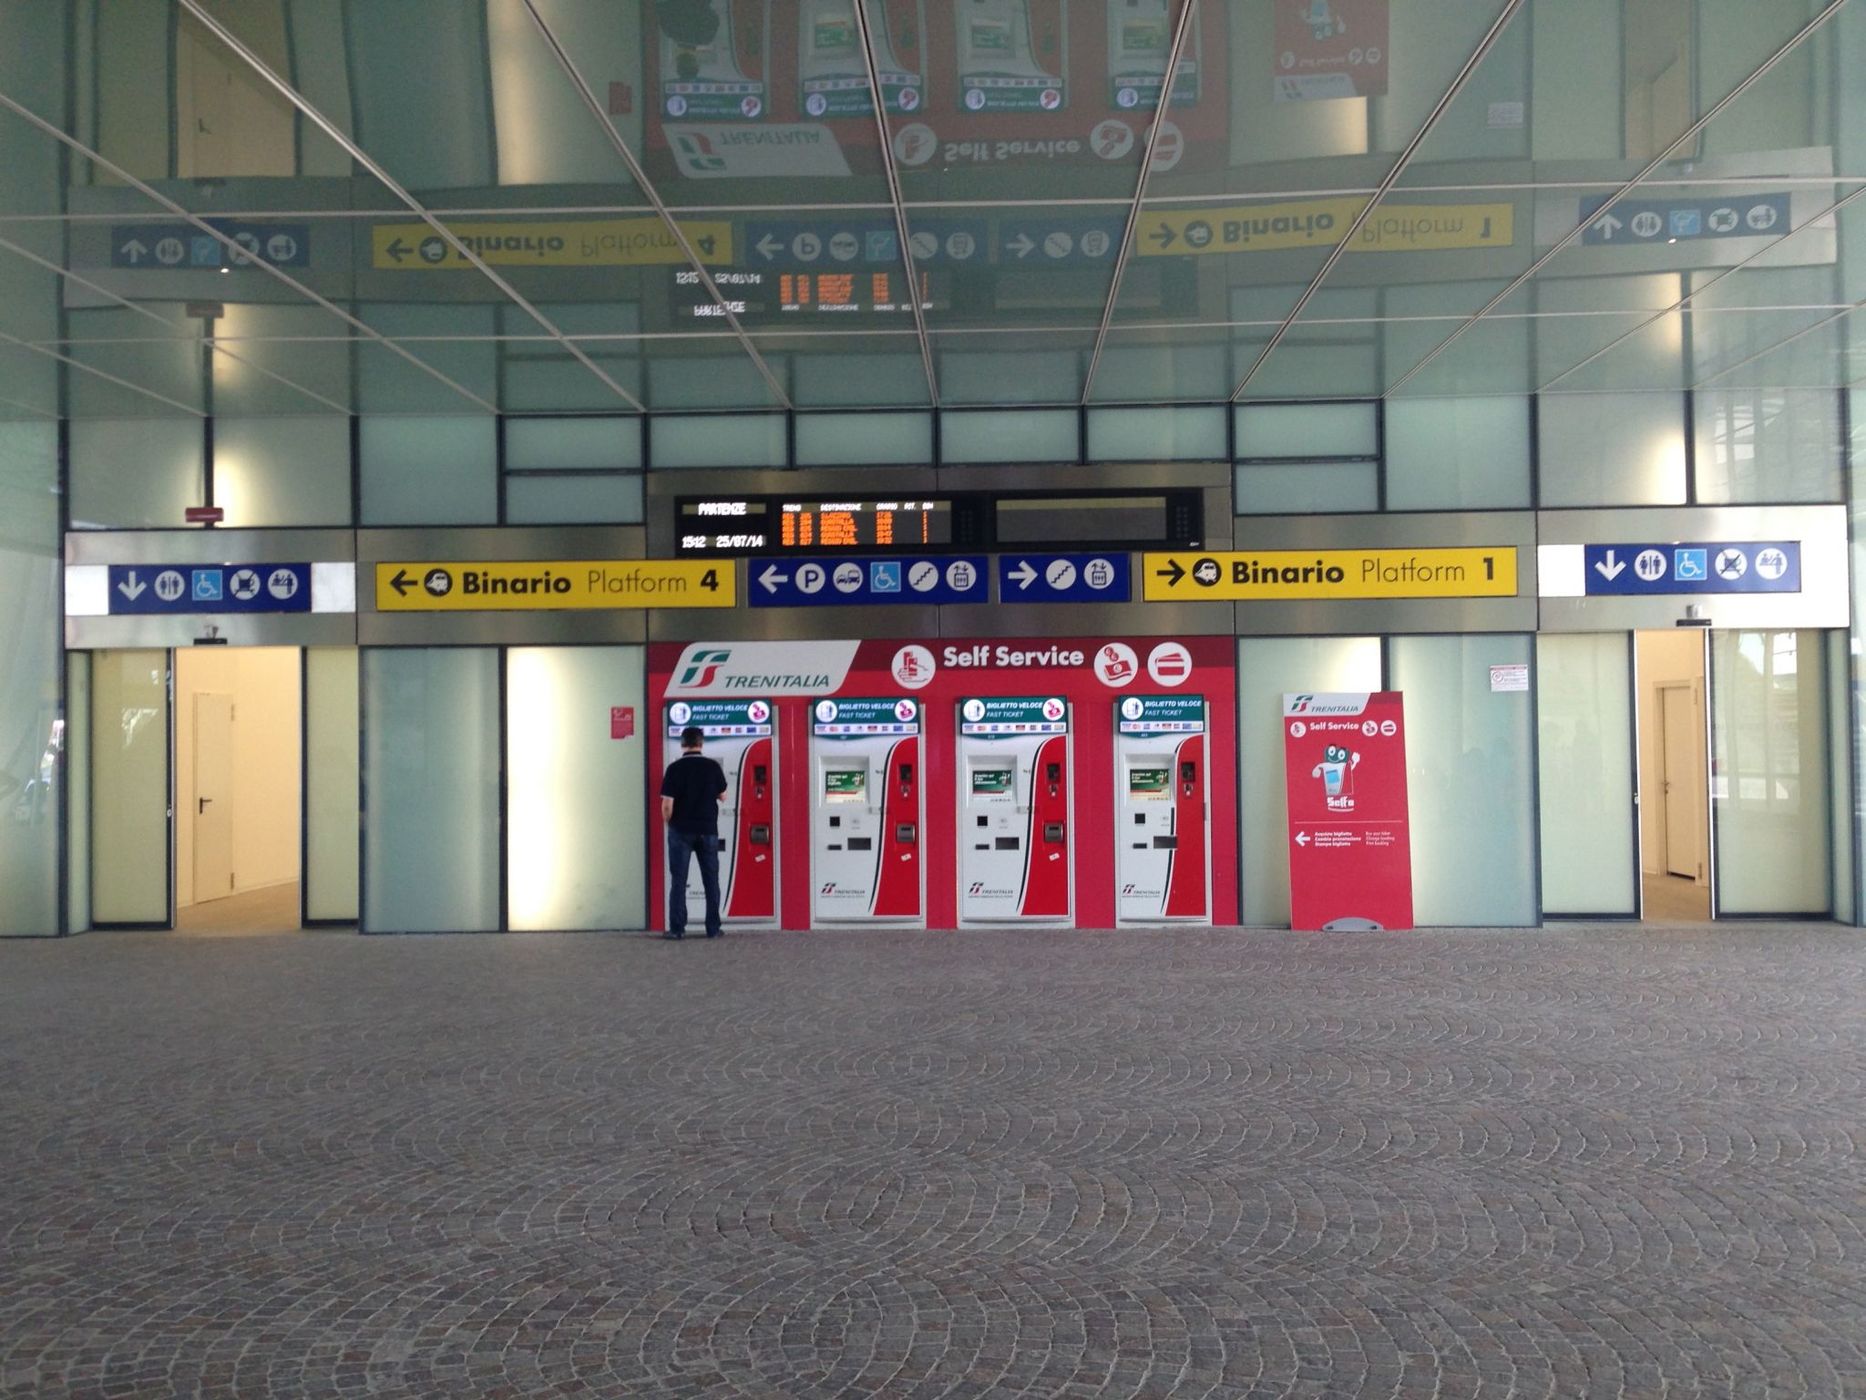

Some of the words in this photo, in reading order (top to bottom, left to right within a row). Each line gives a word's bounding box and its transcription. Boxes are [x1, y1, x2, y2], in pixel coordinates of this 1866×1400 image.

[698, 502, 747, 516] PARTENZE
[715, 534, 763, 548] 25/07/14
[1232, 559, 1345, 584] Binario
[1362, 557, 1465, 583] Platform
[1483, 556, 1494, 580] 1
[462, 571, 571, 595] Binario
[588, 568, 687, 594] Platform
[700, 569, 719, 592] 4
[943, 645, 989, 667] Self
[995, 645, 1084, 667] Service
[725, 674, 830, 688] TRENITALIA
[692, 704, 724, 712] BIGLIETTO
[871, 702, 895, 710] VELOCE
[1311, 705, 1359, 713] TRENITALIA
[855, 711, 876, 719] TICKET
[1310, 721, 1326, 730] Self
[1327, 721, 1359, 730] Service
